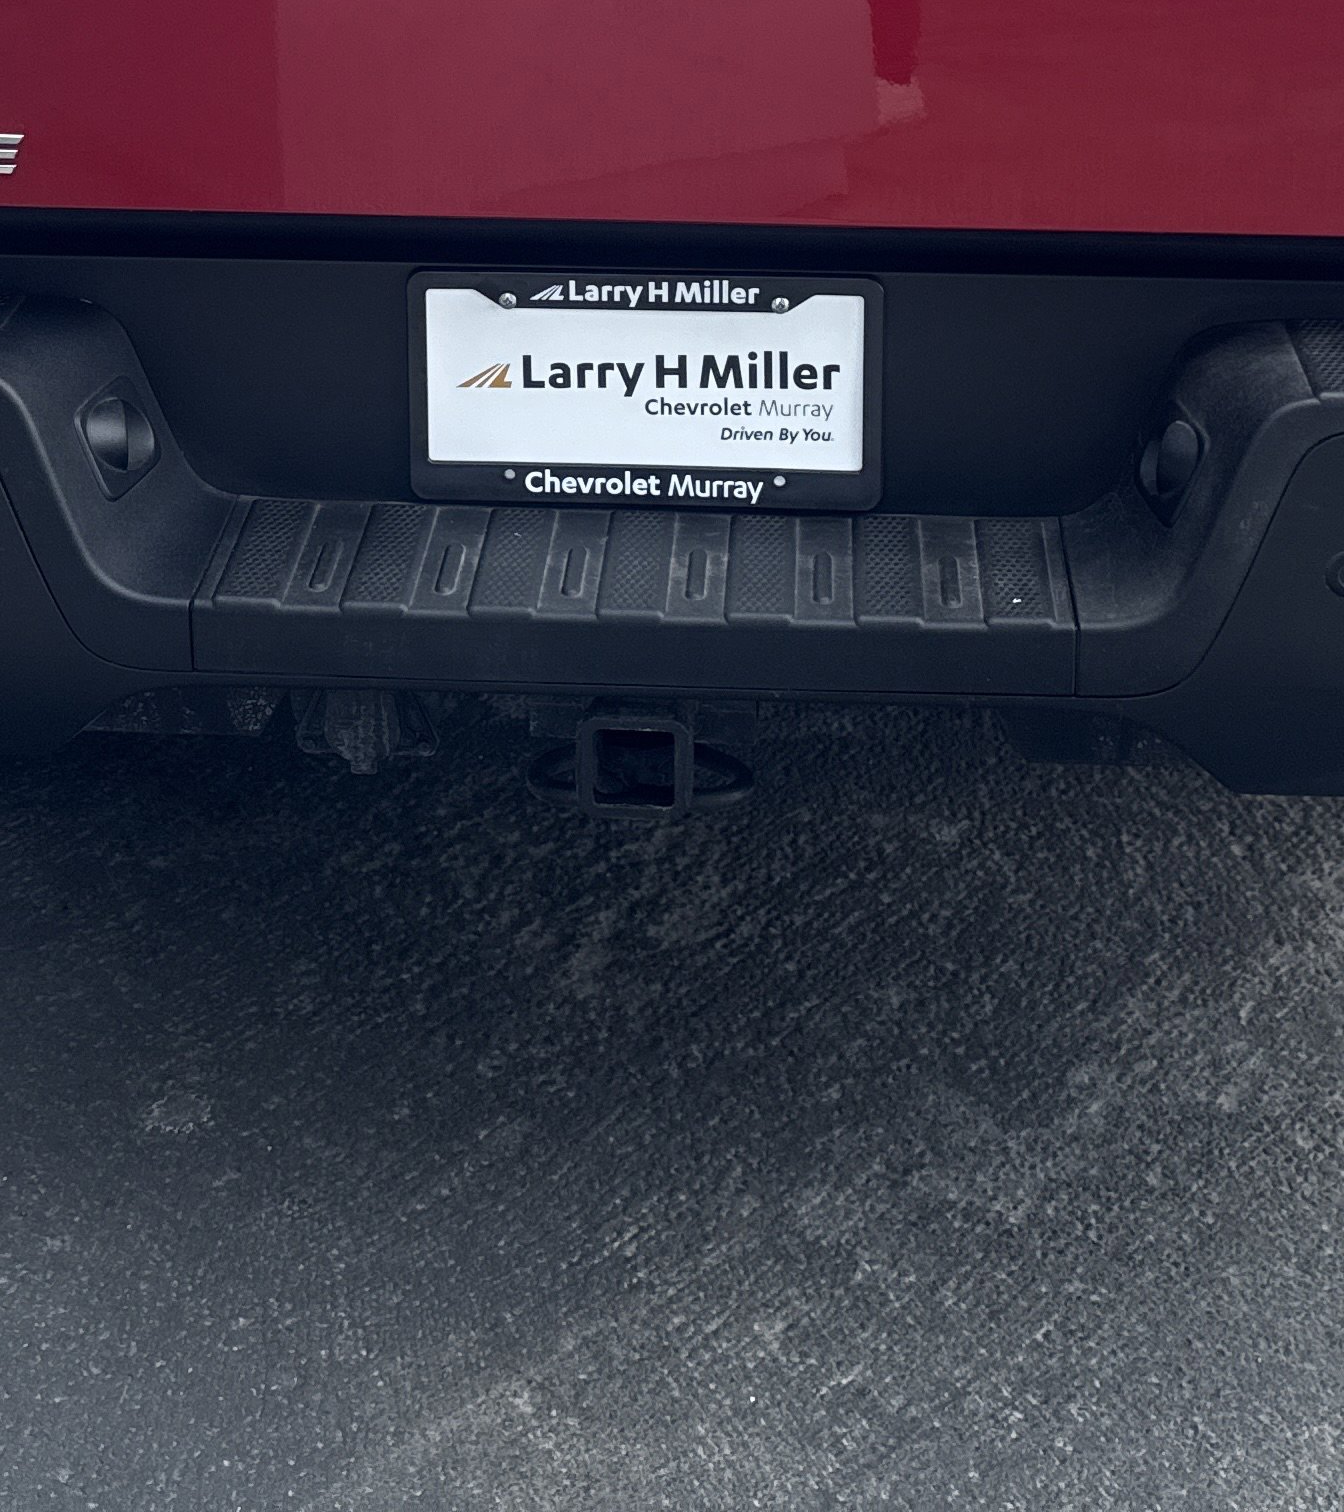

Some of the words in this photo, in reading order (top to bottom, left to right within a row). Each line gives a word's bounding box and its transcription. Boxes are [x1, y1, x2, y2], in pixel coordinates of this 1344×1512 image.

[568, 280, 643, 307] Larry
[648, 282, 669, 303] H
[674, 280, 760, 304] Miller
[522, 354, 645, 397] Larry
[655, 355, 688, 389] H
[699, 351, 841, 390] Miller
[644, 397, 753, 417] Chevrolet
[758, 399, 834, 422] Murray
[720, 426, 774, 441] Driven
[778, 428, 799, 444] By
[524, 470, 661, 496] Chevrolet
[667, 474, 764, 505] Murray
